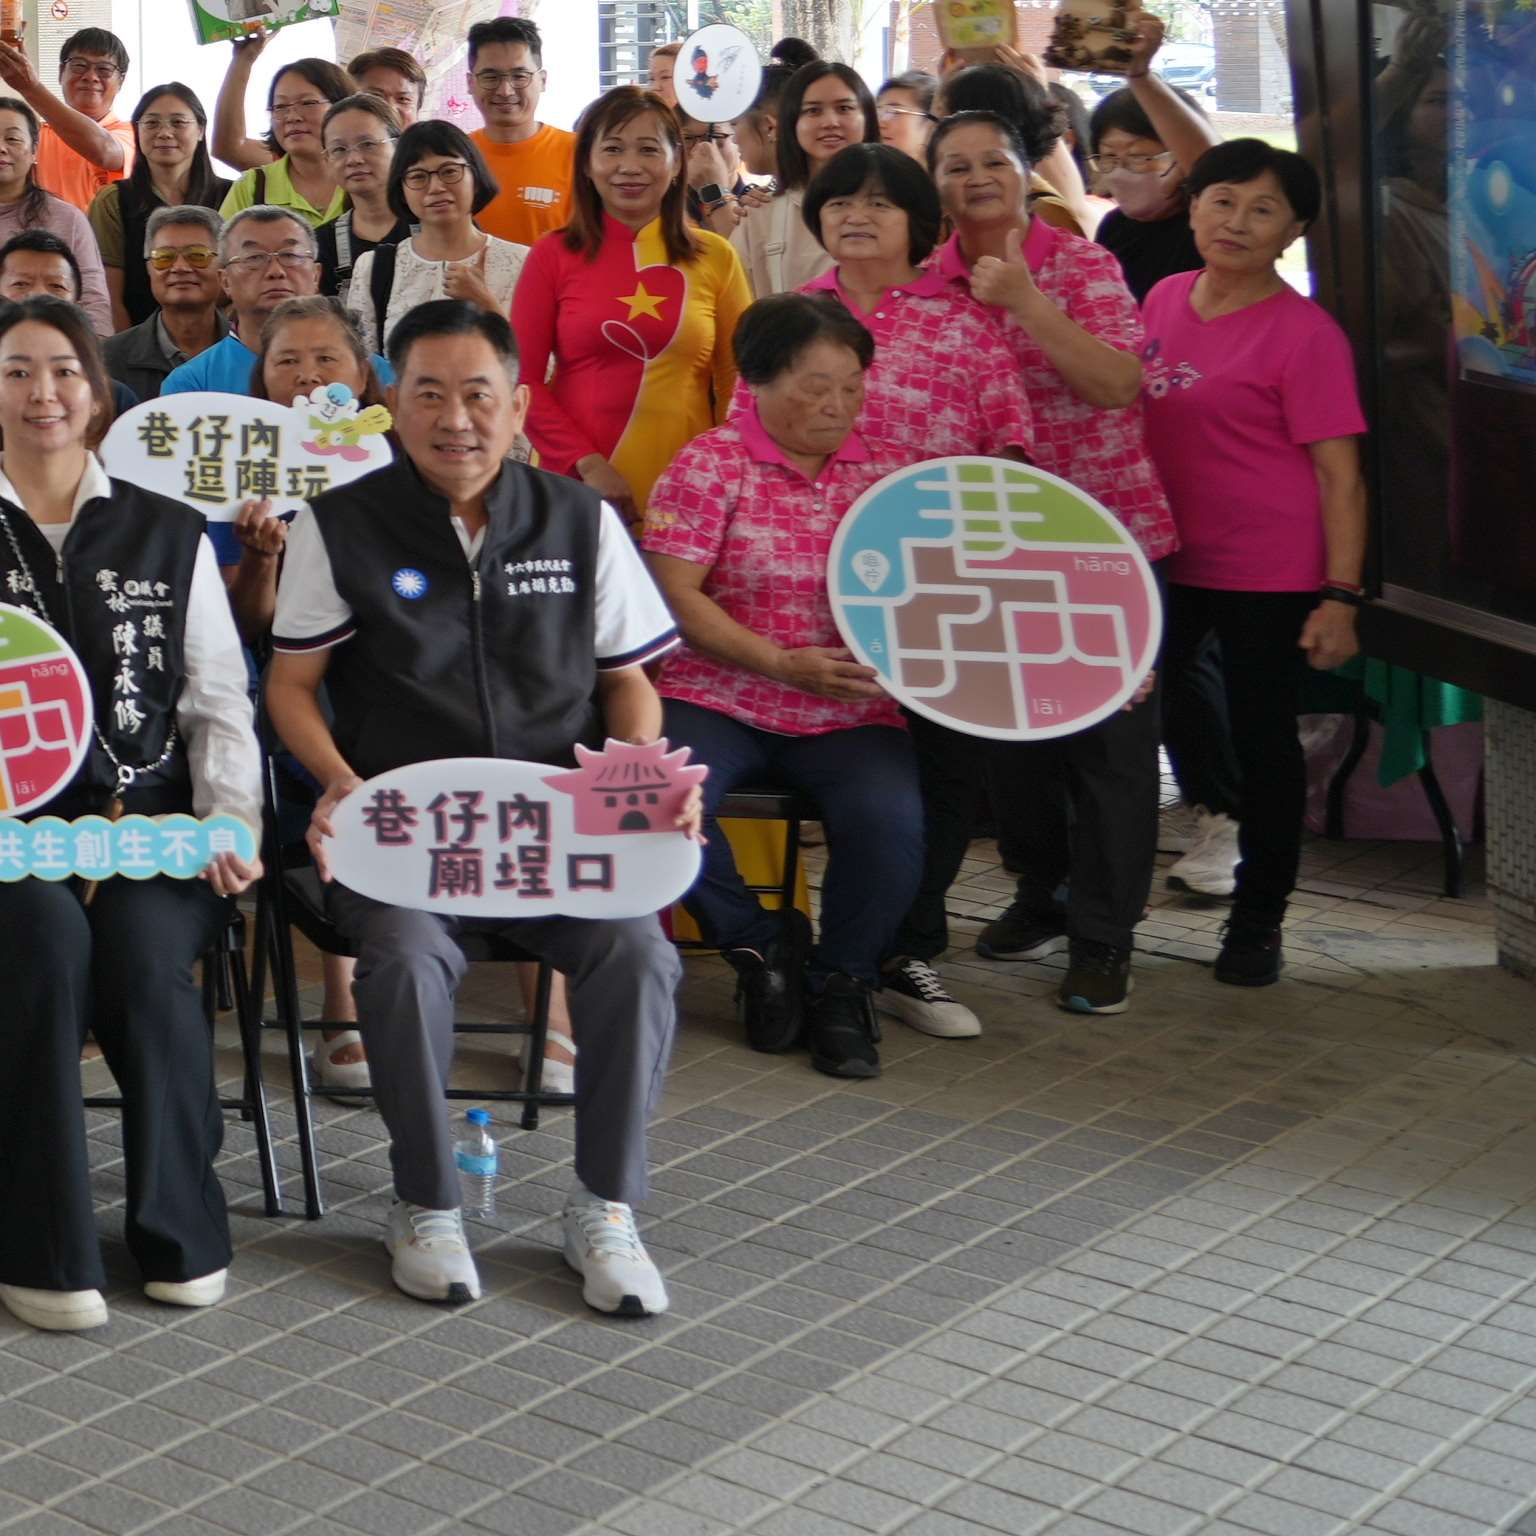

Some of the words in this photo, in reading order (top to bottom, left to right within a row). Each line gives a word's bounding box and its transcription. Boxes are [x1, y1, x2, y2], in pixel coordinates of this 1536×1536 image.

[137, 411, 281, 459] 巷仔內
[183, 457, 330, 503] 逗陣玩
[1073, 556, 1131, 576] hāng
[142, 614, 166, 672] 議員
[112, 620, 147, 734] 陳永修
[361, 789, 553, 846] 巷仔內
[426, 843, 617, 899] 廟埕口
